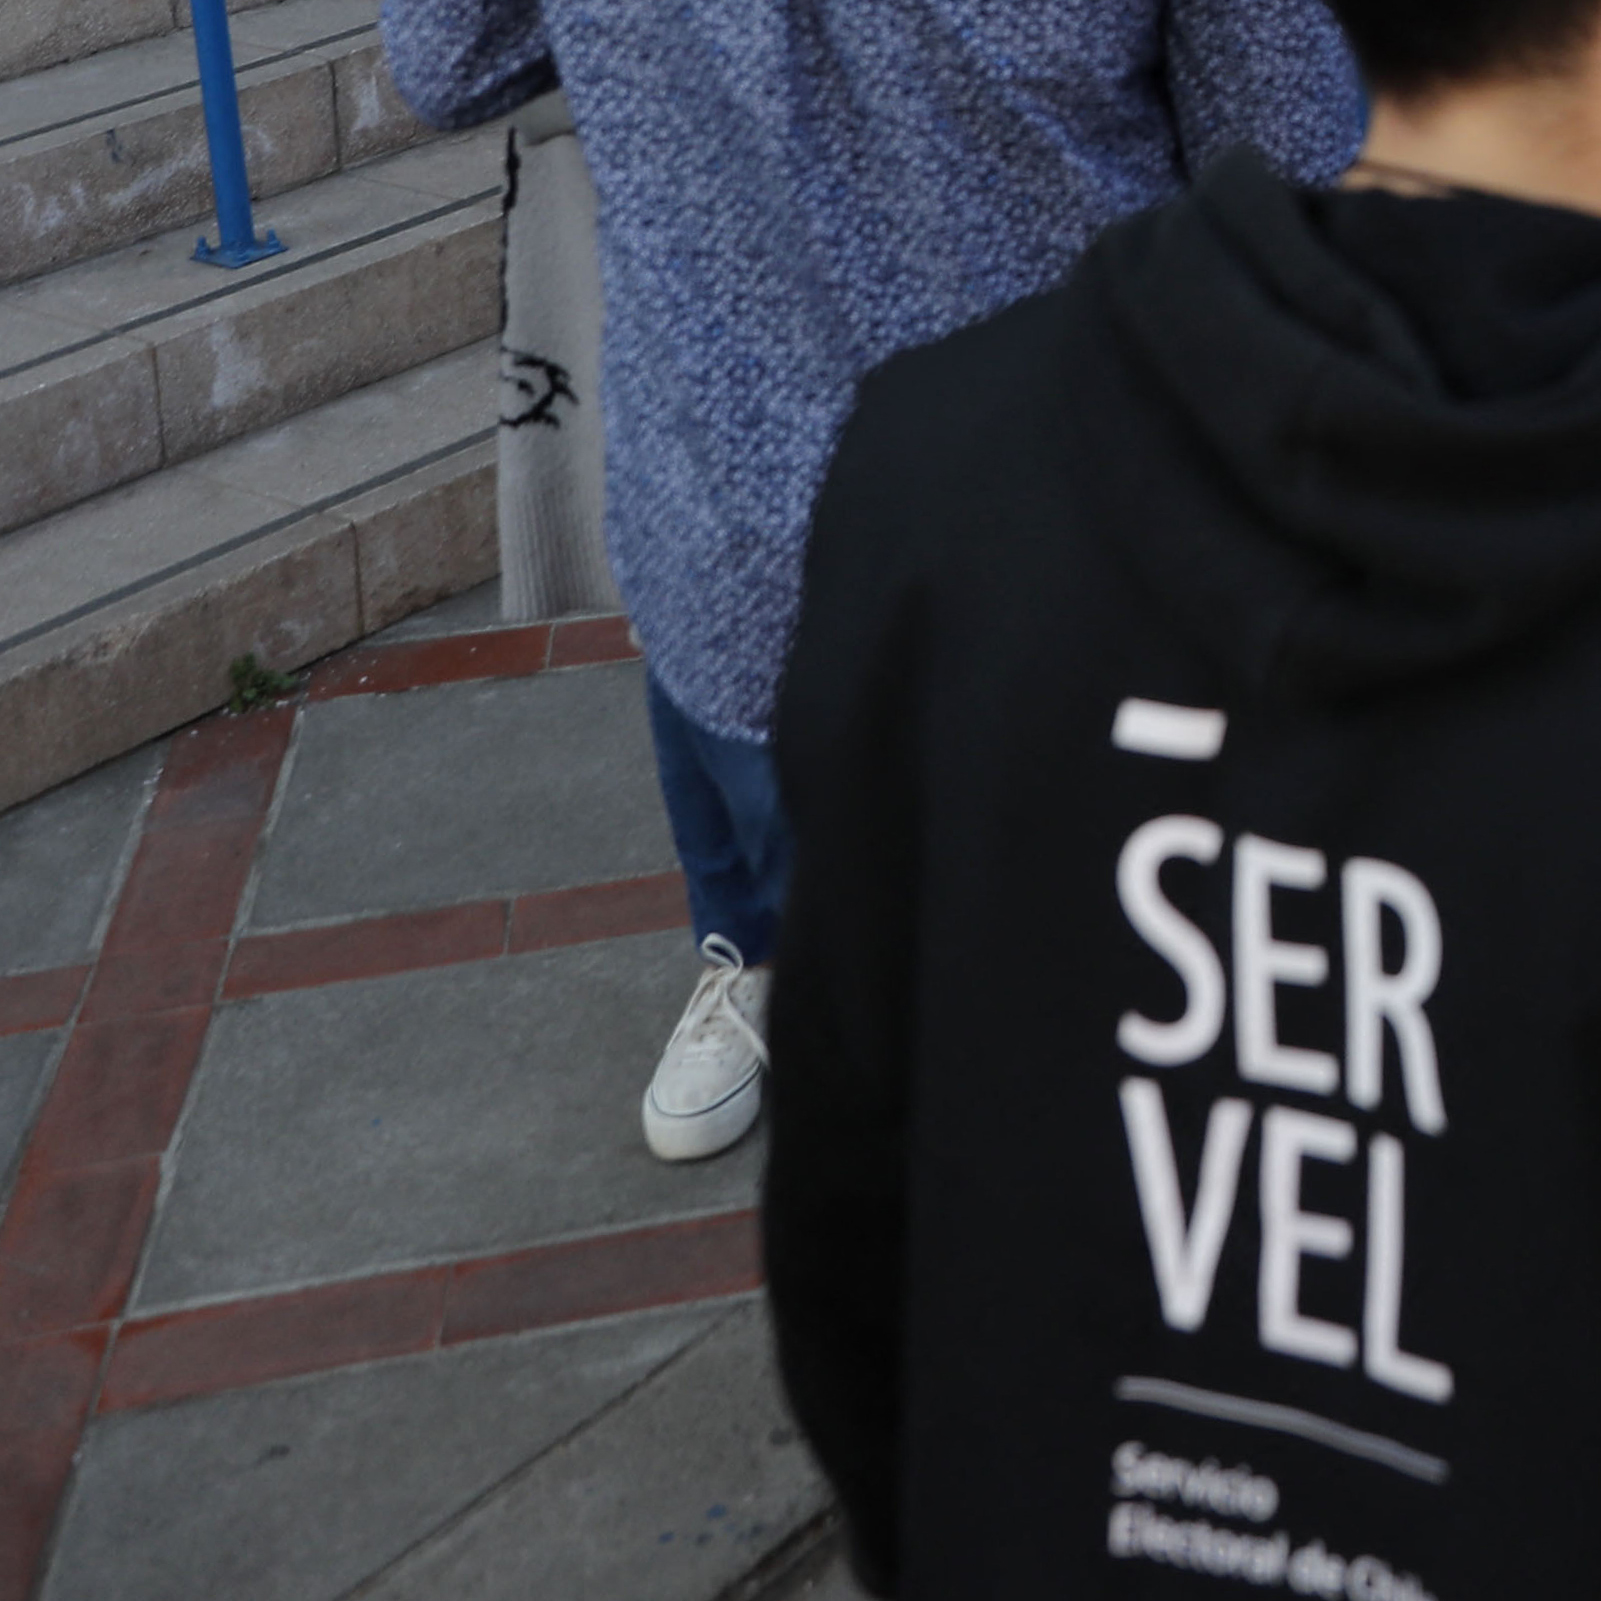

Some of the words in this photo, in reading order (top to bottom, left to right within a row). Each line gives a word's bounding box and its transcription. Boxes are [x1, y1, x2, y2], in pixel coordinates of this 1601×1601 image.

[1115, 813, 1448, 1137] SER
[1117, 1075, 1454, 1403] VEL
[1107, 1501, 1290, 1586] Electoral
[1111, 1440, 1280, 1524] Servicio
